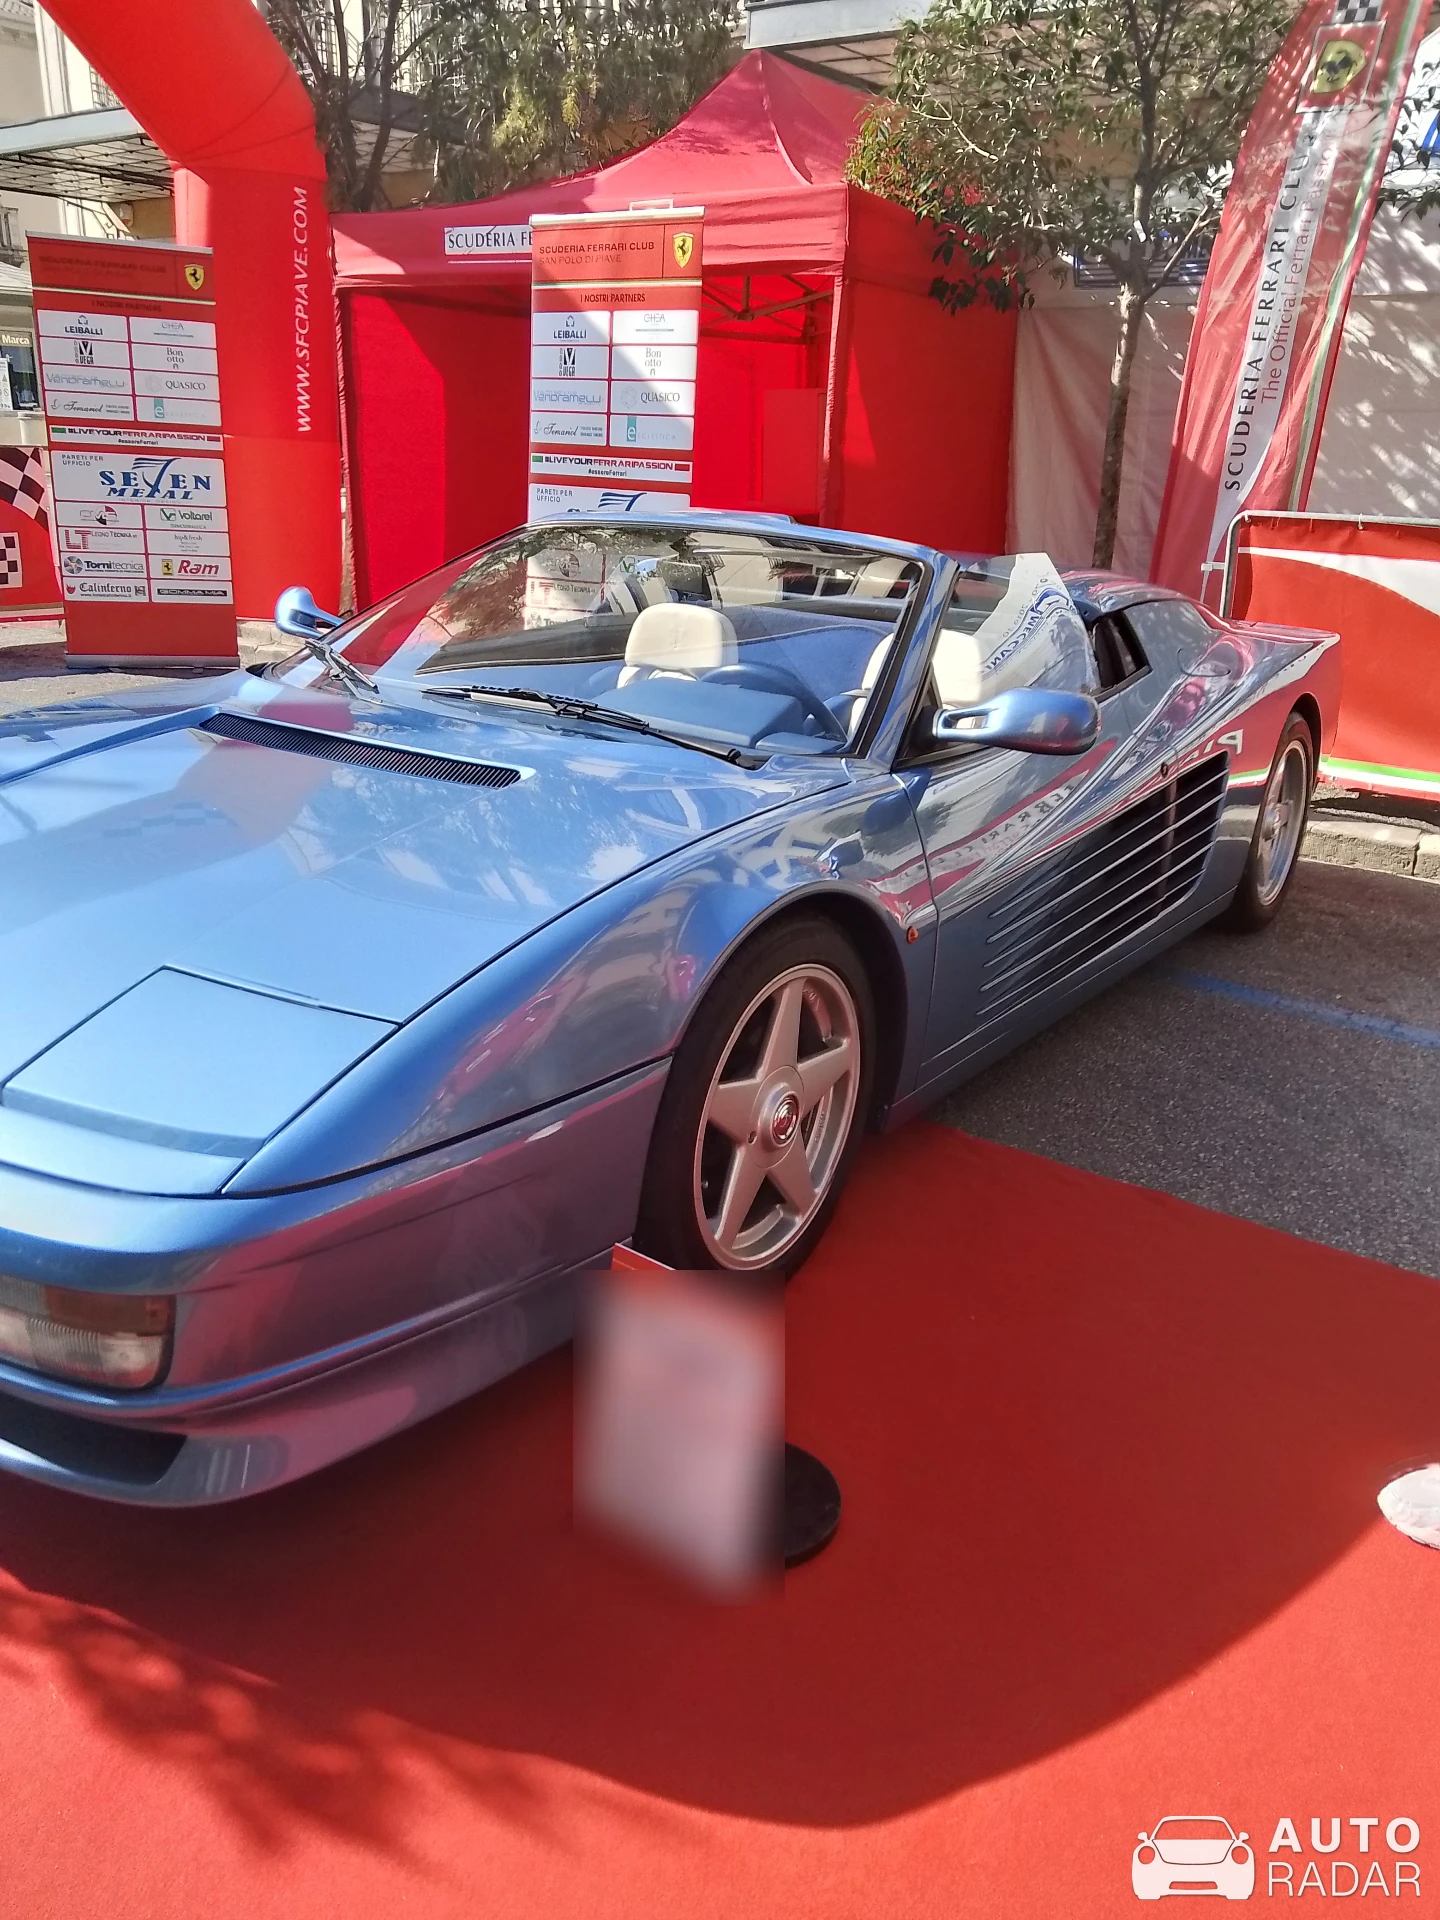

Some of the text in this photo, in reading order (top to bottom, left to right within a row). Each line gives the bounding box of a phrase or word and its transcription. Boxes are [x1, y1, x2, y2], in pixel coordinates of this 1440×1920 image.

[448, 231, 516, 249] SCUDERIA
[539, 241, 655, 254] SCUDERIA FERRARI CLUB
[1284, 218, 1312, 285] Ferrari
[539, 256, 556, 265] SAN
[558, 255, 583, 264] POLO
[597, 254, 622, 263] PIAVE
[584, 294, 609, 302] NOSTRI
[611, 293, 646, 302] PARTNERS
[293, 186, 312, 432] WWW.SFCPIAVE.COM
[64, 325, 104, 336] LEIBALLI
[1269, 292, 1298, 360] Official
[1, 334, 30, 345] Marca
[553, 329, 587, 339] LEIBALLI
[166, 347, 184, 357] Bon
[645, 347, 662, 358] Bon
[79, 355, 94, 364] VEGA
[644, 358, 662, 367] otto
[1224, 356, 1264, 491] SCUDERIA
[1252, 227, 1290, 342] FERRARI
[165, 380, 207, 391] QUASICO
[1261, 368, 1282, 404] The
[640, 391, 681, 404] QUASICO
[67, 427, 206, 442] #LIVEYOURFERRARIPASSION
[544, 455, 674, 471] #LIVEYOURFERRARIPASSION
[536, 487, 573, 497] PARETI PER
[536, 495, 561, 503] UFFICIO
[178, 509, 213, 521] Voltarel
[83, 560, 144, 571] Tornitecnica
[177, 559, 219, 575] Ram
